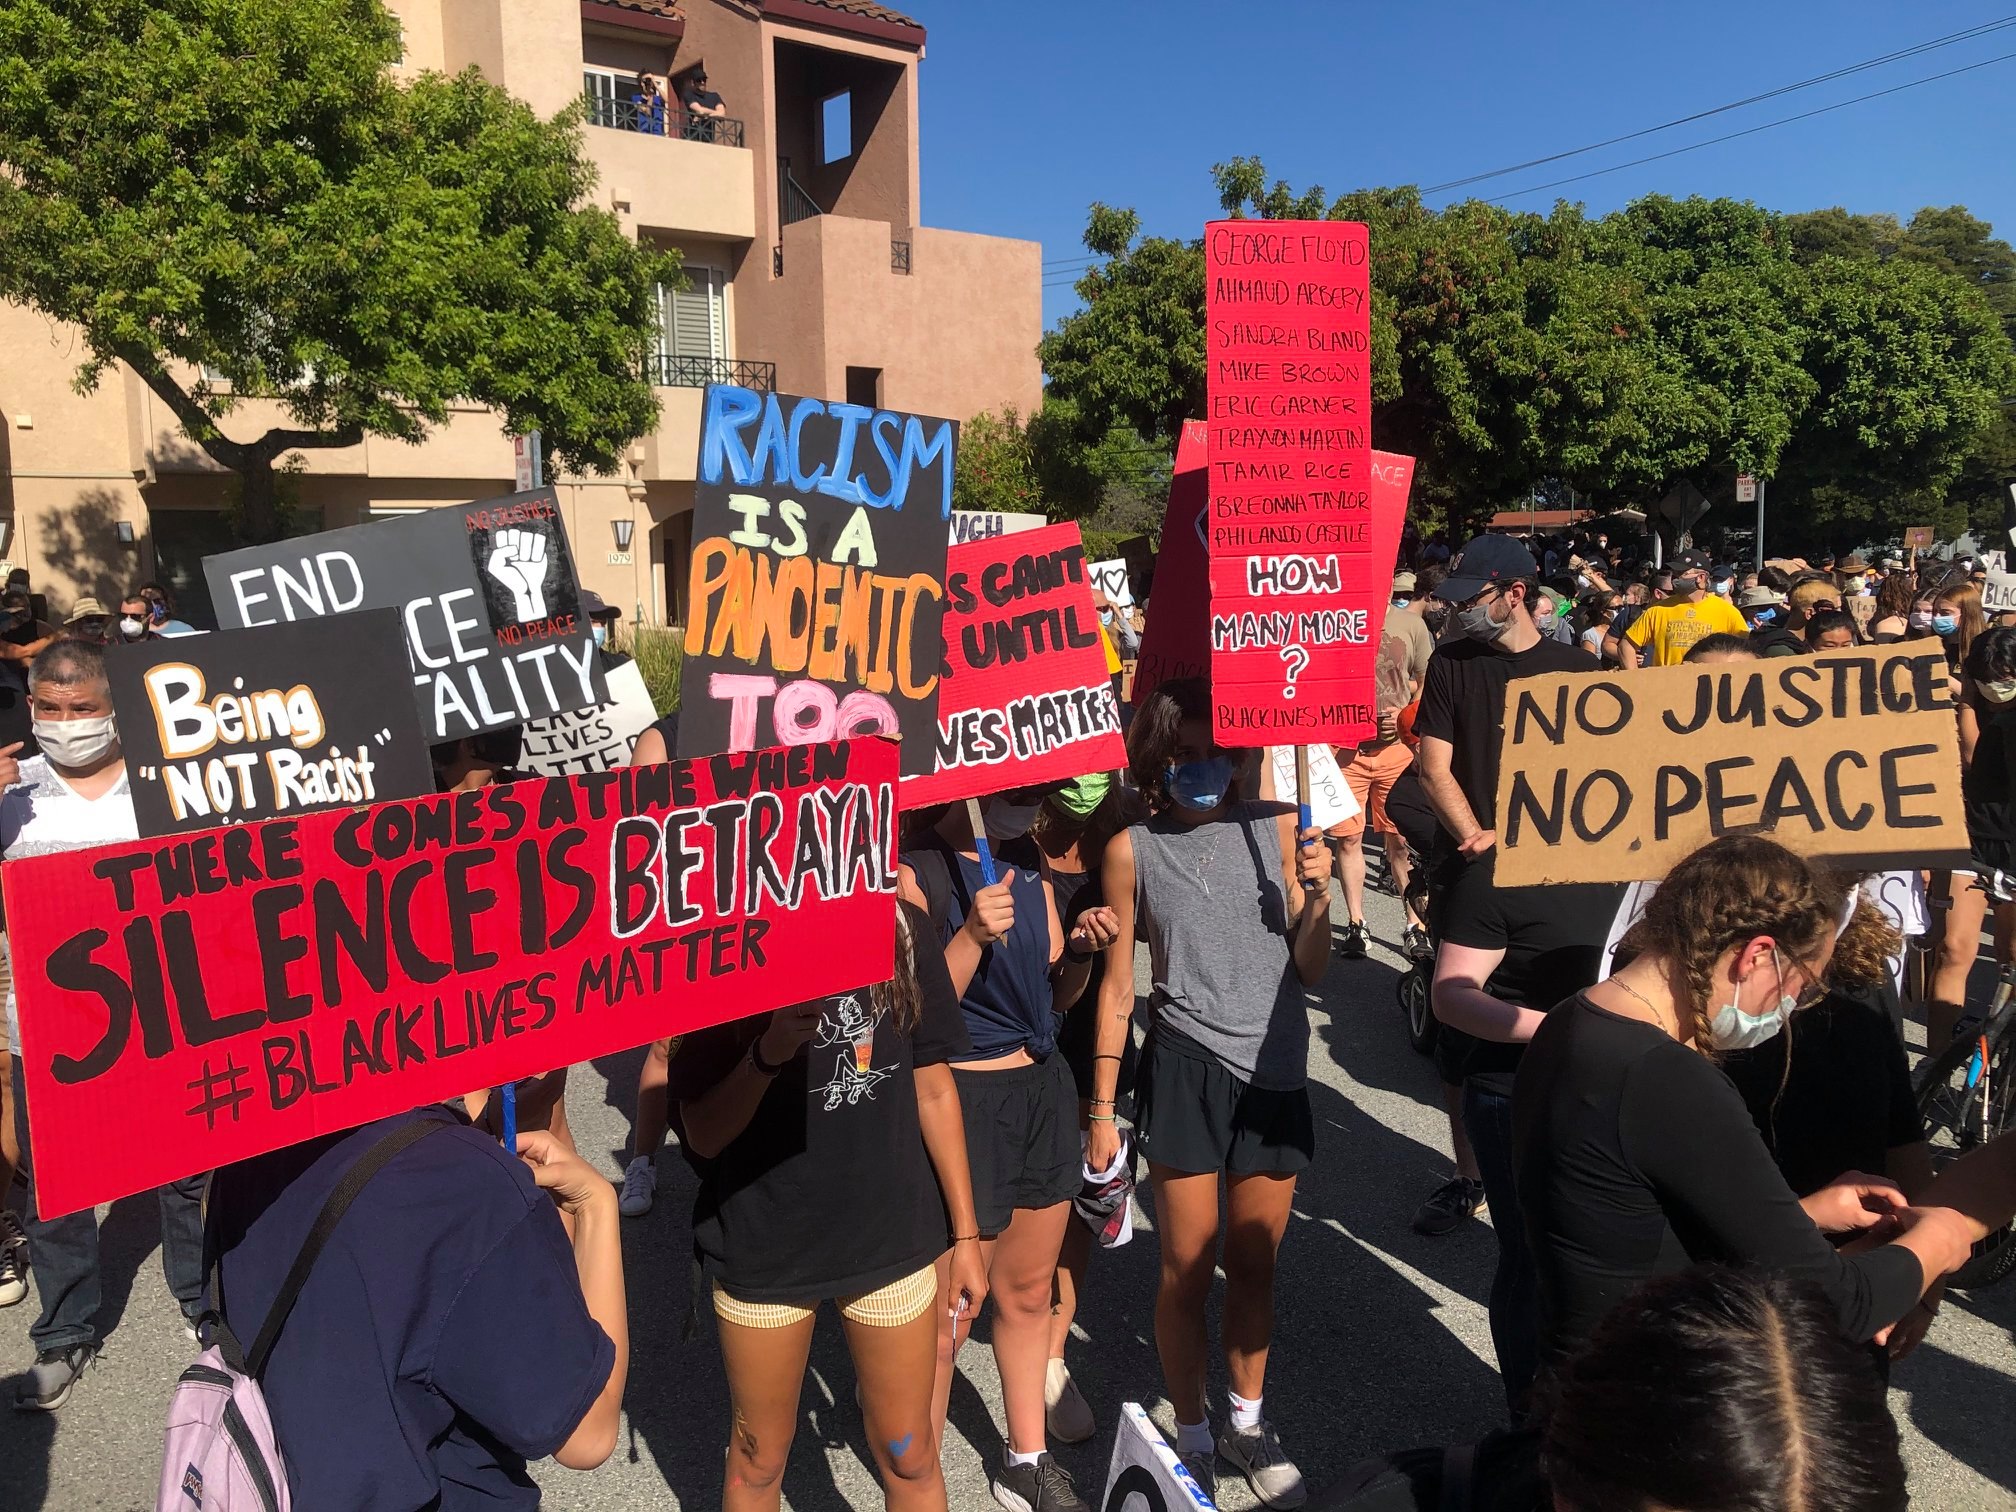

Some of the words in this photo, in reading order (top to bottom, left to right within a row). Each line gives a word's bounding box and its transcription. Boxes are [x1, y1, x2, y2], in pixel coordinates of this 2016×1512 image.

[1212, 228, 1295, 266] GEORGE
[1301, 235, 1366, 267] FLOYD
[1214, 277, 1290, 305] AHMAUD
[1296, 281, 1365, 314] ARBERY
[1214, 320, 1300, 348] SANDRA
[1307, 328, 1368, 353] BLAND
[1219, 359, 1272, 383] MIKE
[1281, 362, 1360, 383] BROWN
[1213, 395, 1265, 419] ERIC
[1270, 394, 1358, 416] GARNER
[701, 383, 955, 521] RACISM
[1299, 425, 1364, 451] MARTIN
[1214, 461, 1295, 482] TAMIR
[1304, 461, 1353, 480] RICE
[465, 510, 491, 533] NO
[493, 497, 556, 527] JUSTICE
[728, 493, 809, 557] IS
[831, 505, 878, 568] A
[1216, 493, 1308, 518] BREONNA
[1308, 490, 1370, 511] TAYLOR
[608, 553, 631, 564] 1979
[1214, 524, 1301, 548] PHILANDO
[229, 551, 365, 628] END
[981, 544, 1085, 606] CANT
[1246, 553, 1342, 597] HOW
[405, 587, 490, 670] CE
[496, 622, 522, 648] NO
[526, 614, 578, 642] PEACE
[683, 536, 943, 700] PANDEMIC
[961, 604, 1098, 670] UNTIL
[1212, 611, 1293, 652] MANY
[1299, 609, 1370, 645] MORE
[414, 637, 594, 737] ALITY
[1279, 643, 1310, 699] ?
[143, 661, 326, 760] Being
[708, 672, 900, 754] TOO
[1007, 681, 1122, 761] MATTER
[1217, 704, 1271, 731] BLACK
[1272, 705, 1318, 729] LIVES
[1320, 703, 1378, 727] MATTER
[1512, 681, 1634, 745] NO
[1661, 654, 1954, 736] JUSTICE
[522, 718, 614, 757] LIVES
[1655, 743, 1944, 842] PEACE
[95, 820, 303, 912] THERE
[334, 789, 524, 868] COMES
[709, 739, 850, 801] WHEN
[46, 846, 498, 1086] SILENCE
[517, 828, 598, 956] IS
[610, 782, 900, 938] BETRAYAL
[575, 918, 771, 1014] MATTER
